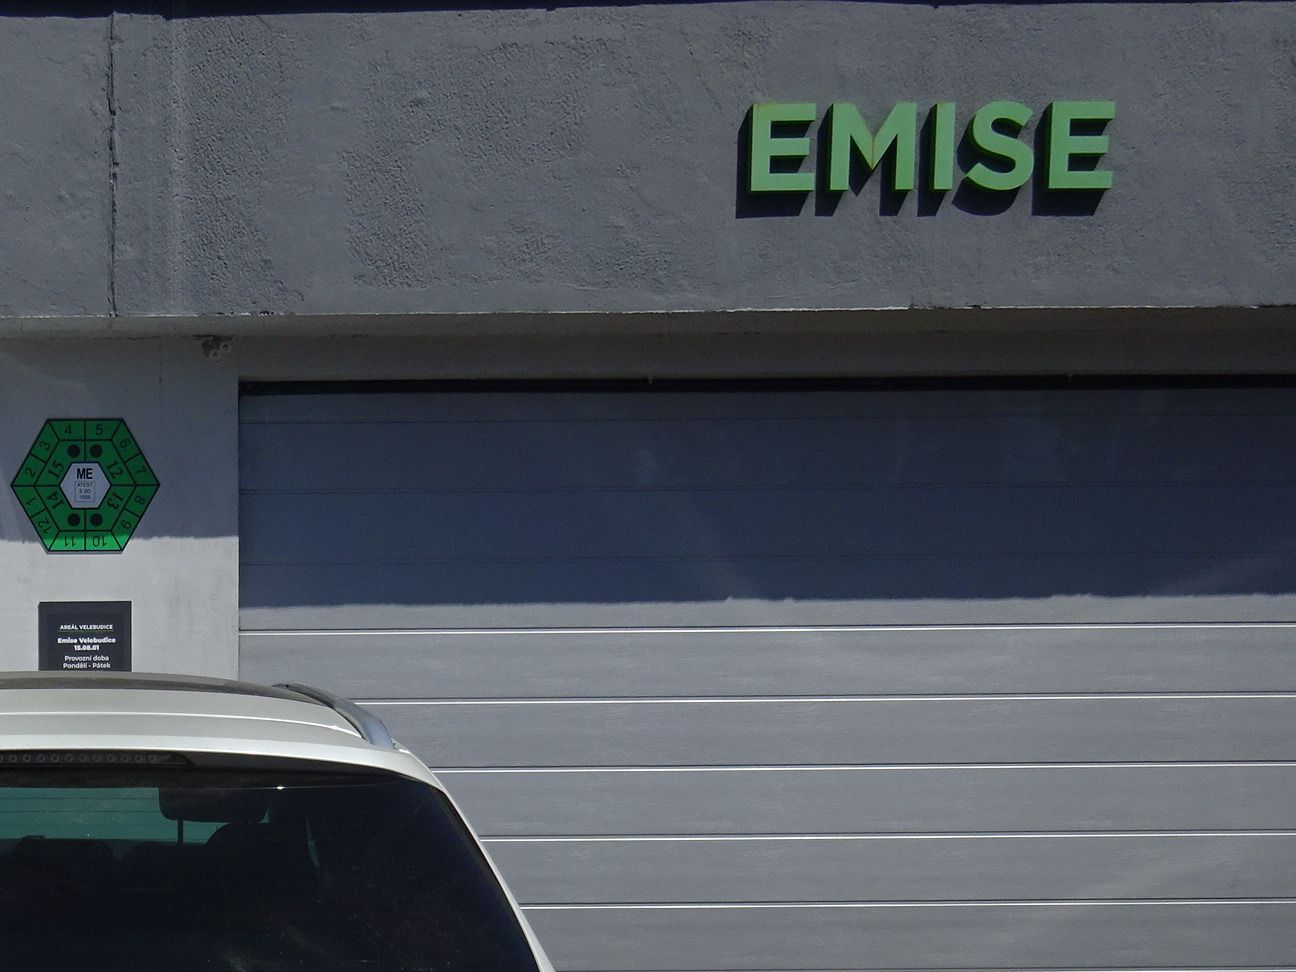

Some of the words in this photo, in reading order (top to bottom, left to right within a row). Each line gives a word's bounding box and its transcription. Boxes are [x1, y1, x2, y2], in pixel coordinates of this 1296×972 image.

[749, 101, 1116, 193] EMISE
[64, 424, 73, 436] 4
[95, 424, 104, 436] 5
[76, 468, 93, 480] ME
